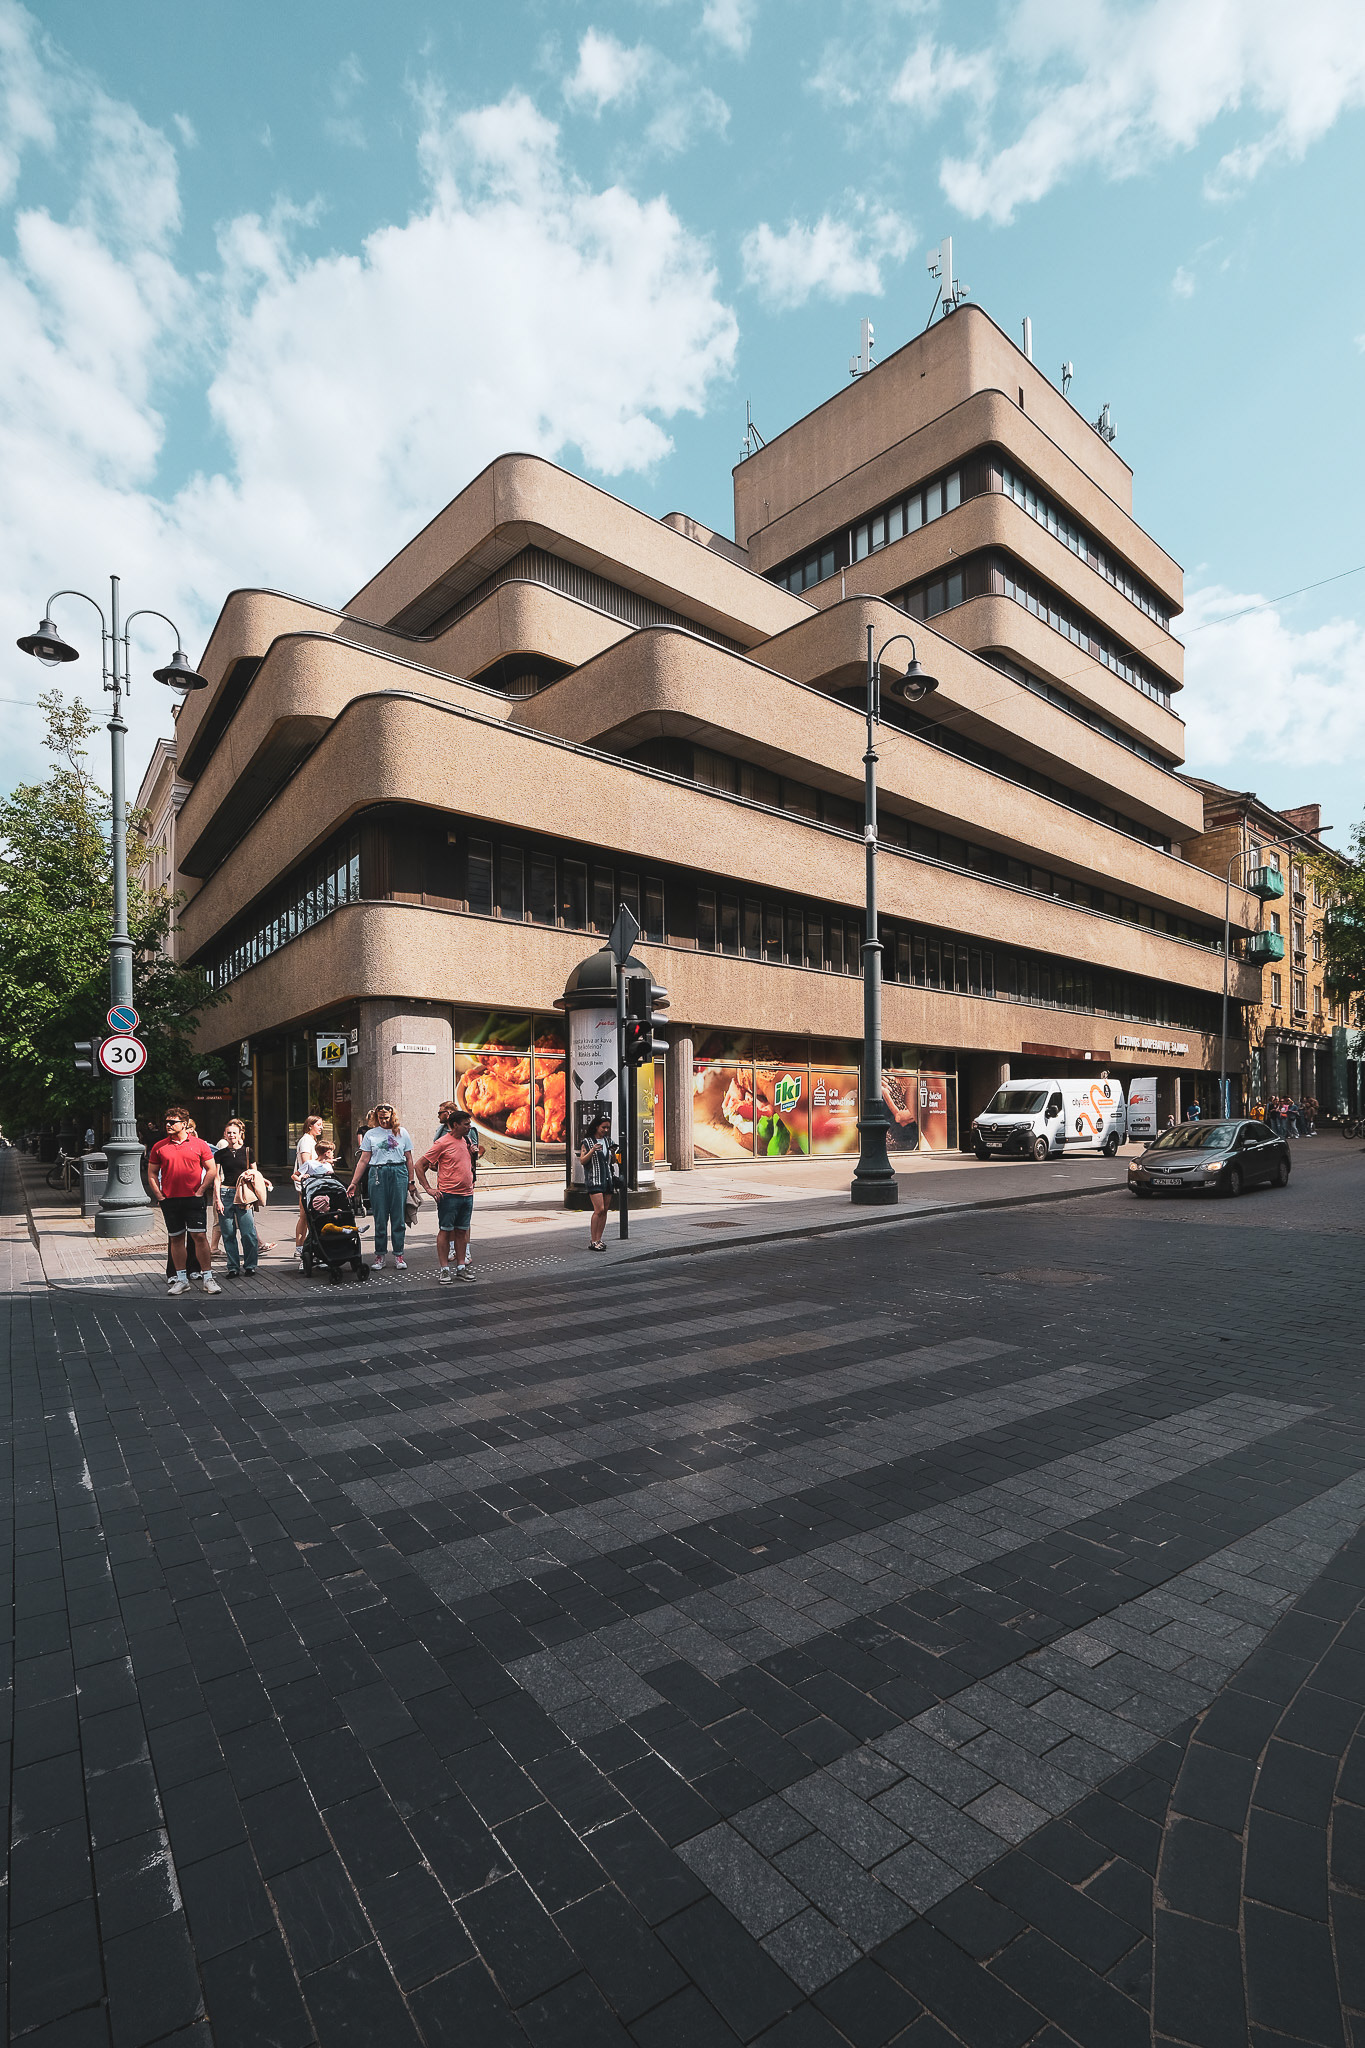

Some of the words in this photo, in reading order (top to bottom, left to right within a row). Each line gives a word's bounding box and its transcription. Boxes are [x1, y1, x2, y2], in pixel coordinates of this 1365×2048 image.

[111, 1047, 137, 1063] 30
[321, 1042, 345, 1061] iki
[775, 1077, 801, 1103] iki
